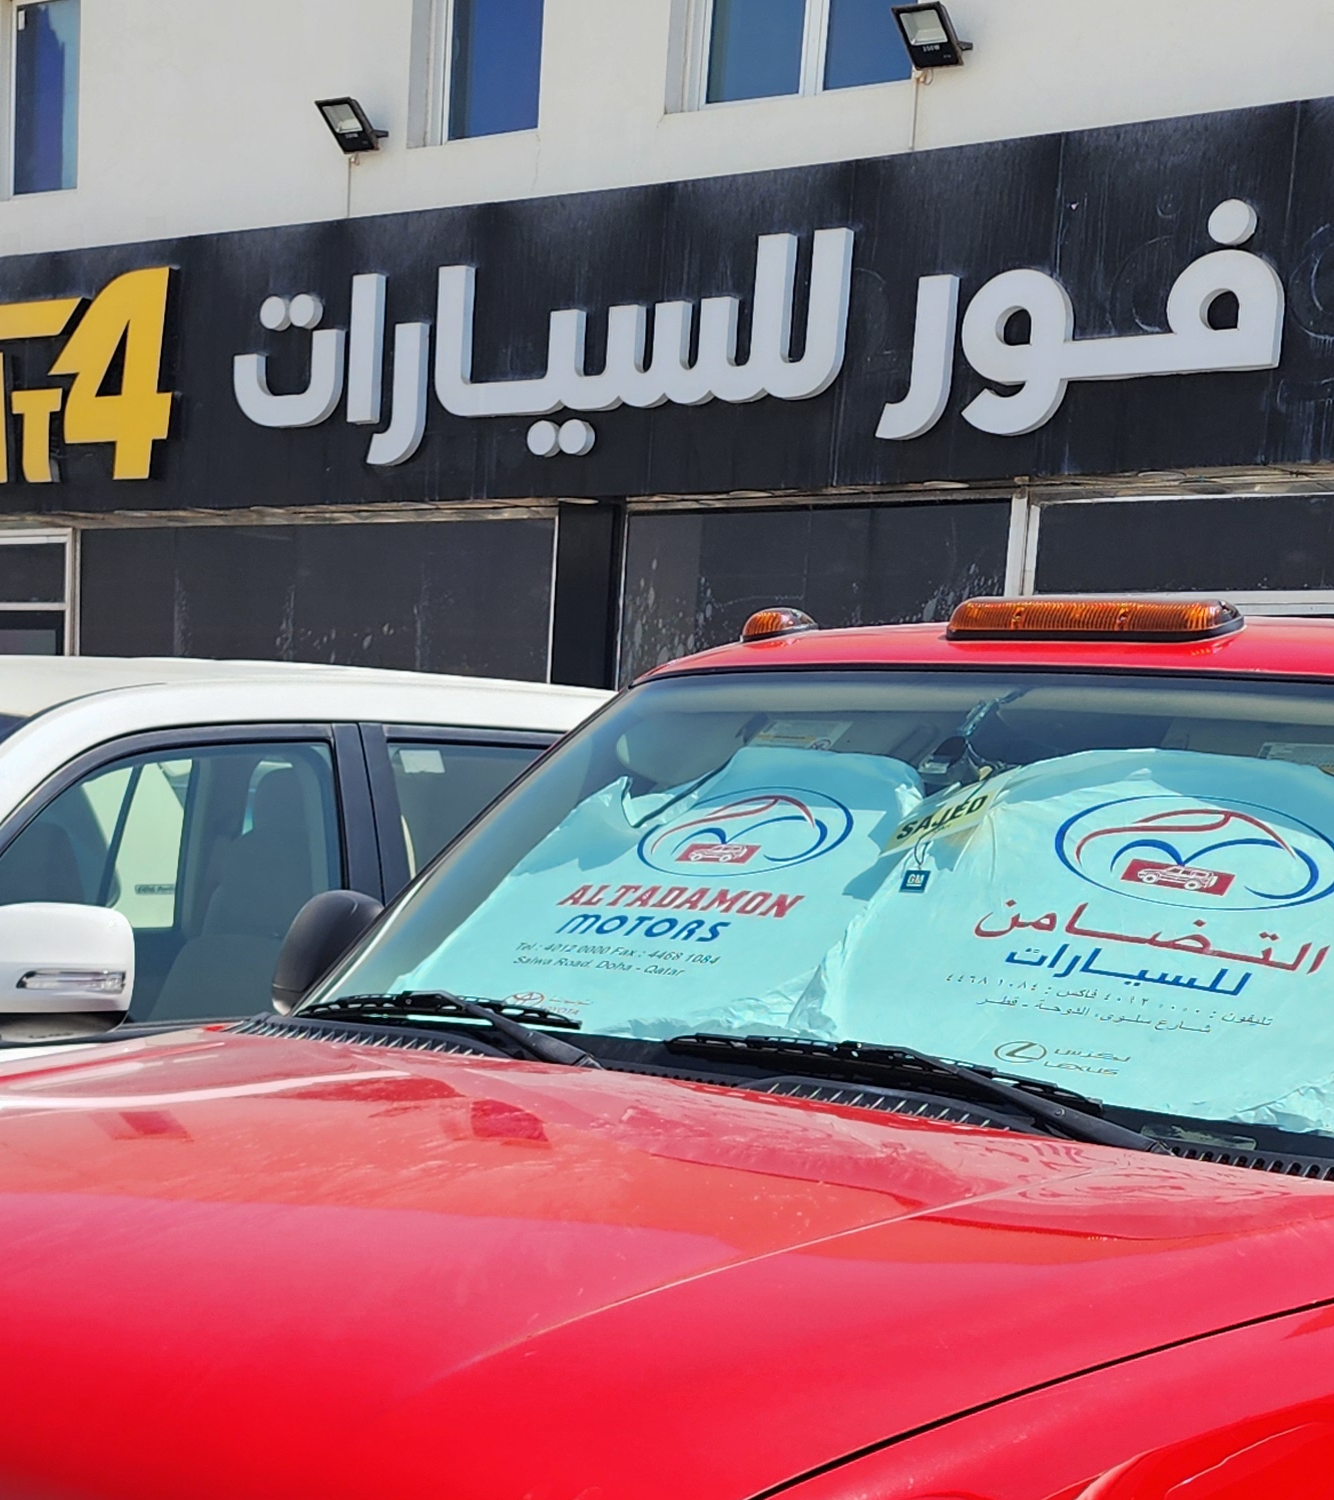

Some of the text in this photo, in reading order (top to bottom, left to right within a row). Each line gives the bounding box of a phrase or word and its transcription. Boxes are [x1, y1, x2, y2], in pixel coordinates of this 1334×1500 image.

[875, 198, 1286, 440] فور
[234, 227, 855, 466] للسيارات
[555, 913, 732, 943] MOTORS
[556, 884, 805, 919] ALTADAMON
[974, 899, 1331, 976] التضامن
[1005, 943, 1252, 996] للسيارات
[1043, 1060, 1119, 1075] LEXUS
